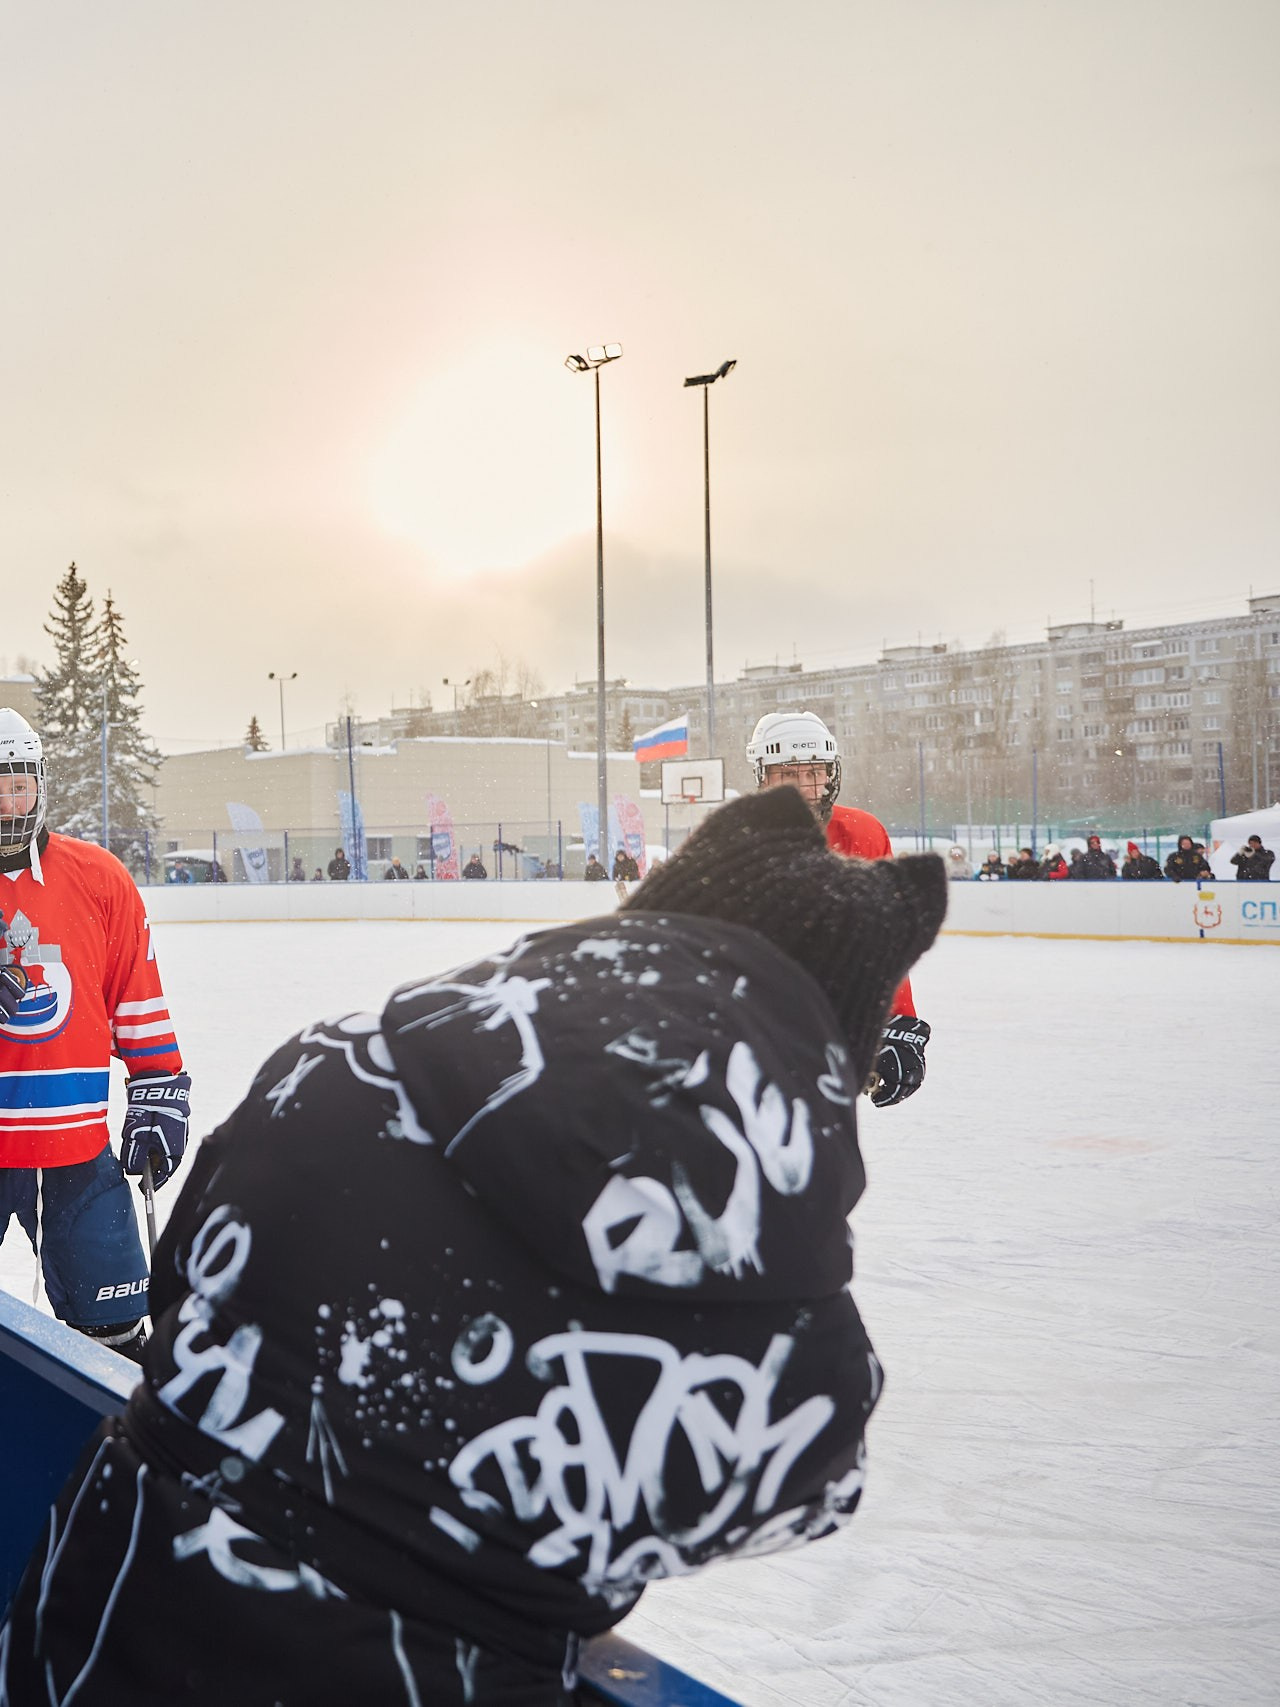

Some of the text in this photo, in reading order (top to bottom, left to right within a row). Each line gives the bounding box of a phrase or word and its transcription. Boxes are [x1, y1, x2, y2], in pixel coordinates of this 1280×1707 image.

[1242, 900, 1280, 920] СП
[881, 1027, 927, 1046] AUER
[95, 1277, 150, 1301] BAUE
